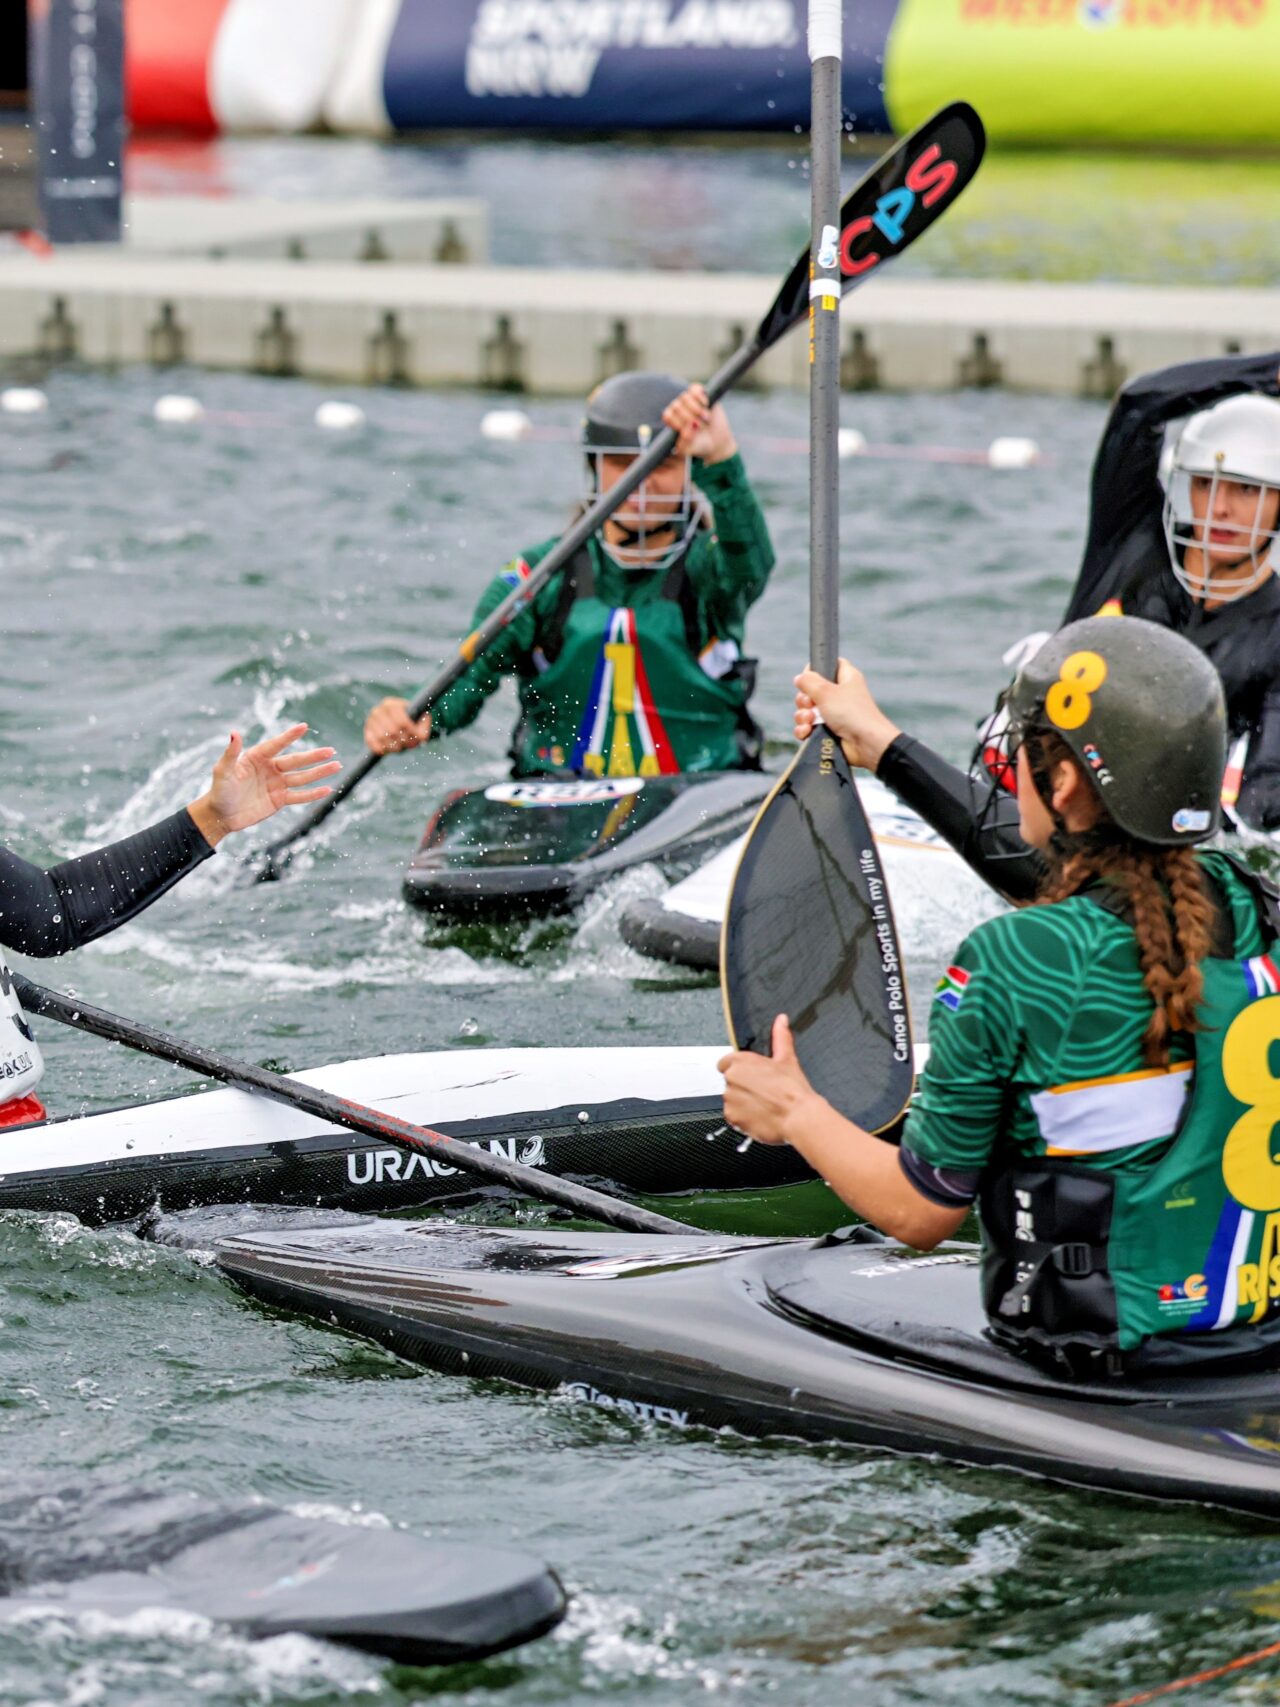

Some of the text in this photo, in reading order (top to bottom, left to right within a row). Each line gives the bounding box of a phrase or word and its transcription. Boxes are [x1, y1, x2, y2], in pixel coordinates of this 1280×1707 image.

[839, 143, 958, 276] CPS
[604, 643, 635, 713] 1
[1045, 651, 1108, 730] 8
[859, 849, 910, 1062] Canoe Polo Sports in my life
